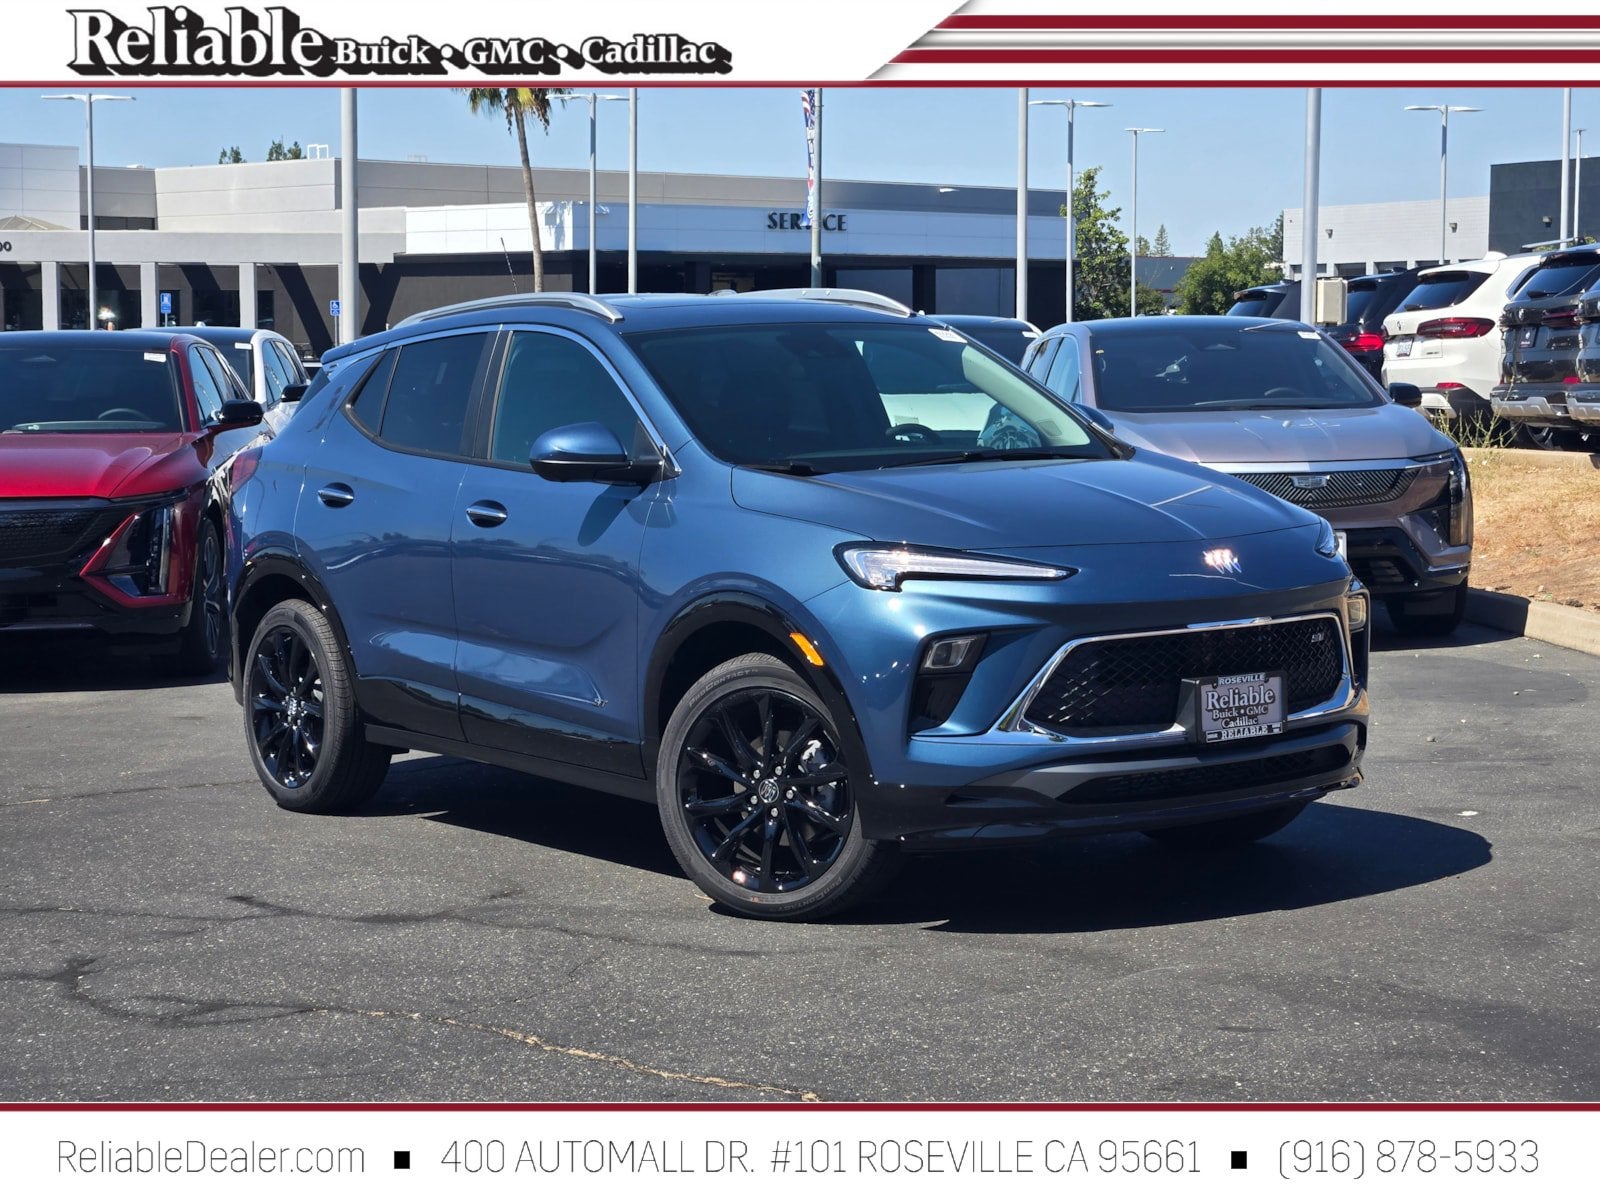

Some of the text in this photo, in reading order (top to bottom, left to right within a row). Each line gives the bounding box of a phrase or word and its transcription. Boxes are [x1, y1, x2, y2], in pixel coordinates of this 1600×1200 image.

[767, 212, 847, 231] SERCE
[1218, 672, 1266, 686] ROSEVILLE
[1206, 684, 1275, 711] Reliable
[1212, 704, 1268, 720] Buick GMC
[1221, 717, 1258, 729] Cadillac
[1221, 725, 1268, 740] RELIABLE
